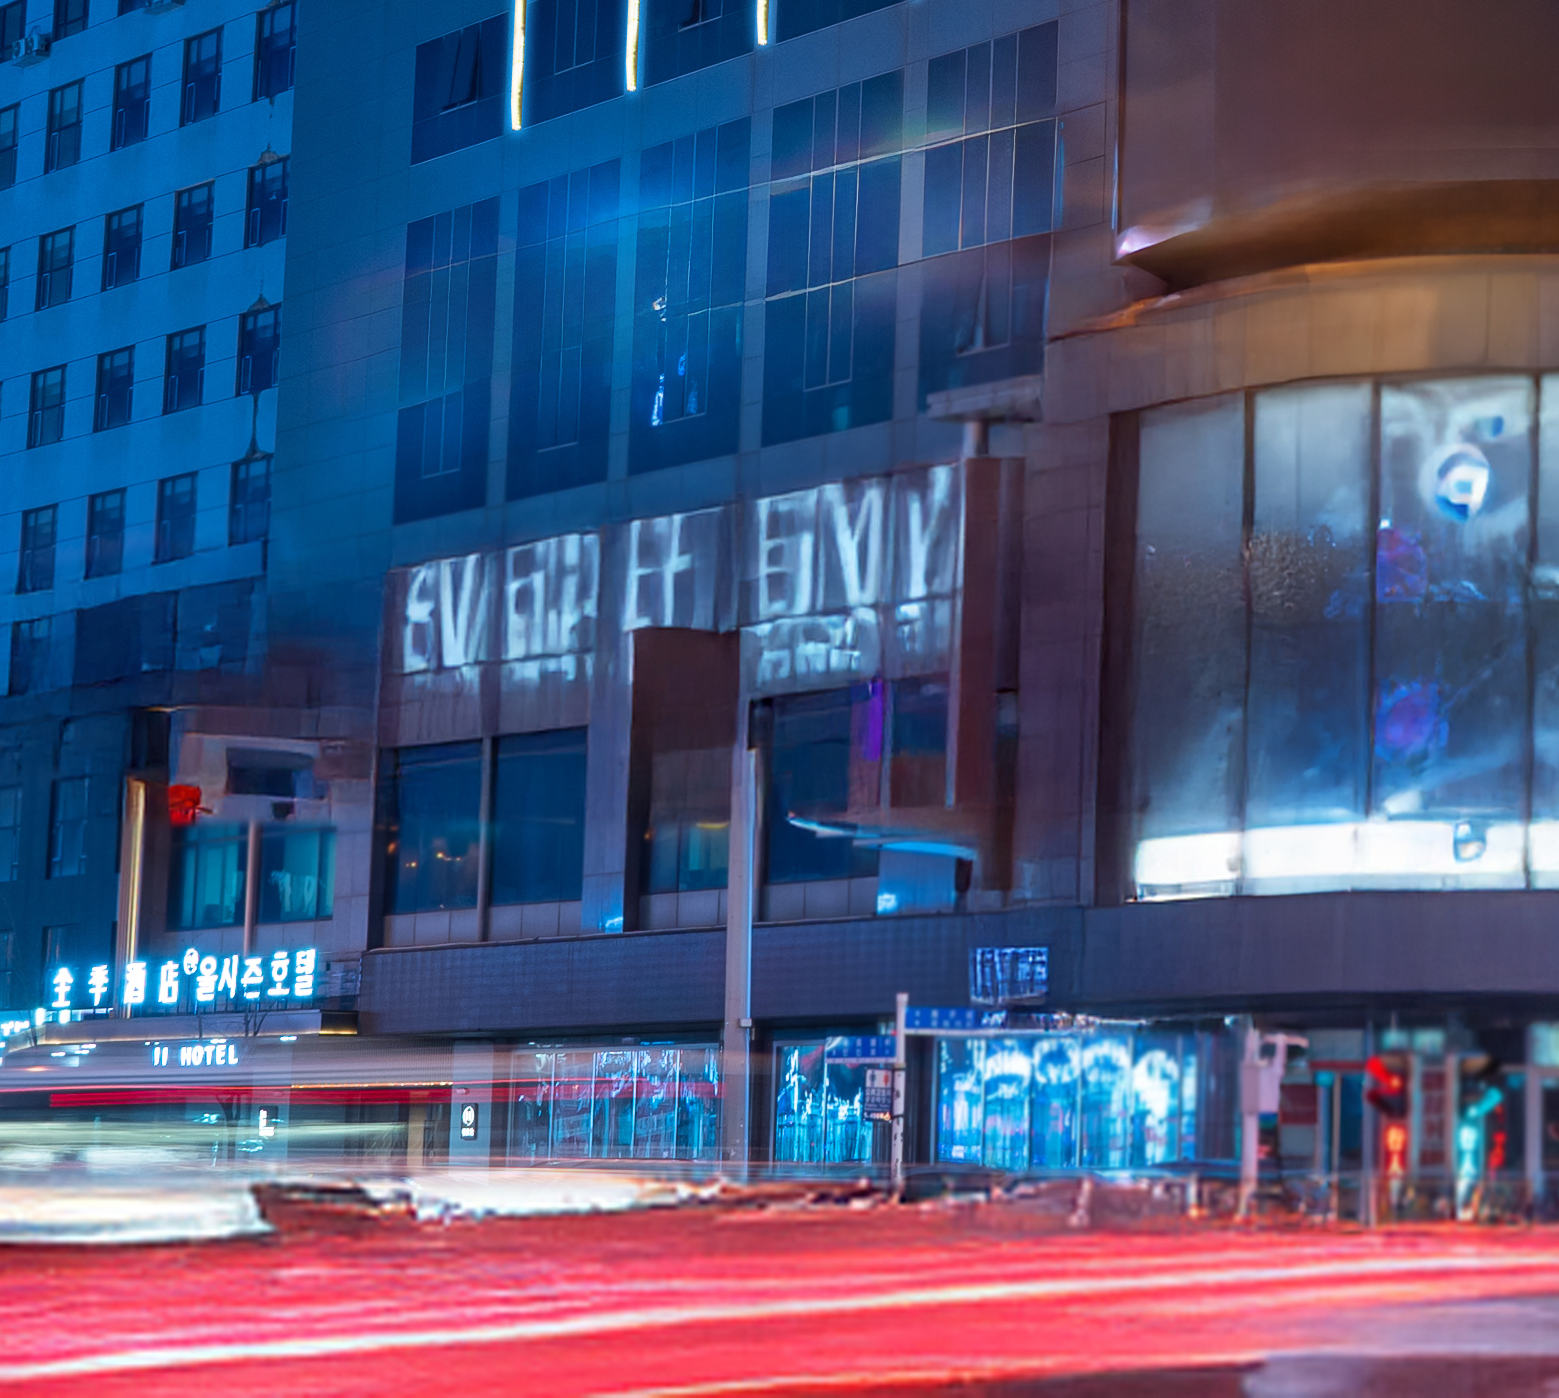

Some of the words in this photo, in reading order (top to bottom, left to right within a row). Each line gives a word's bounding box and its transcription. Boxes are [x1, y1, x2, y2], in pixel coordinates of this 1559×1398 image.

[52, 960, 179, 1008] 全季酒店
[180, 1044, 239, 1066] HOTEL
